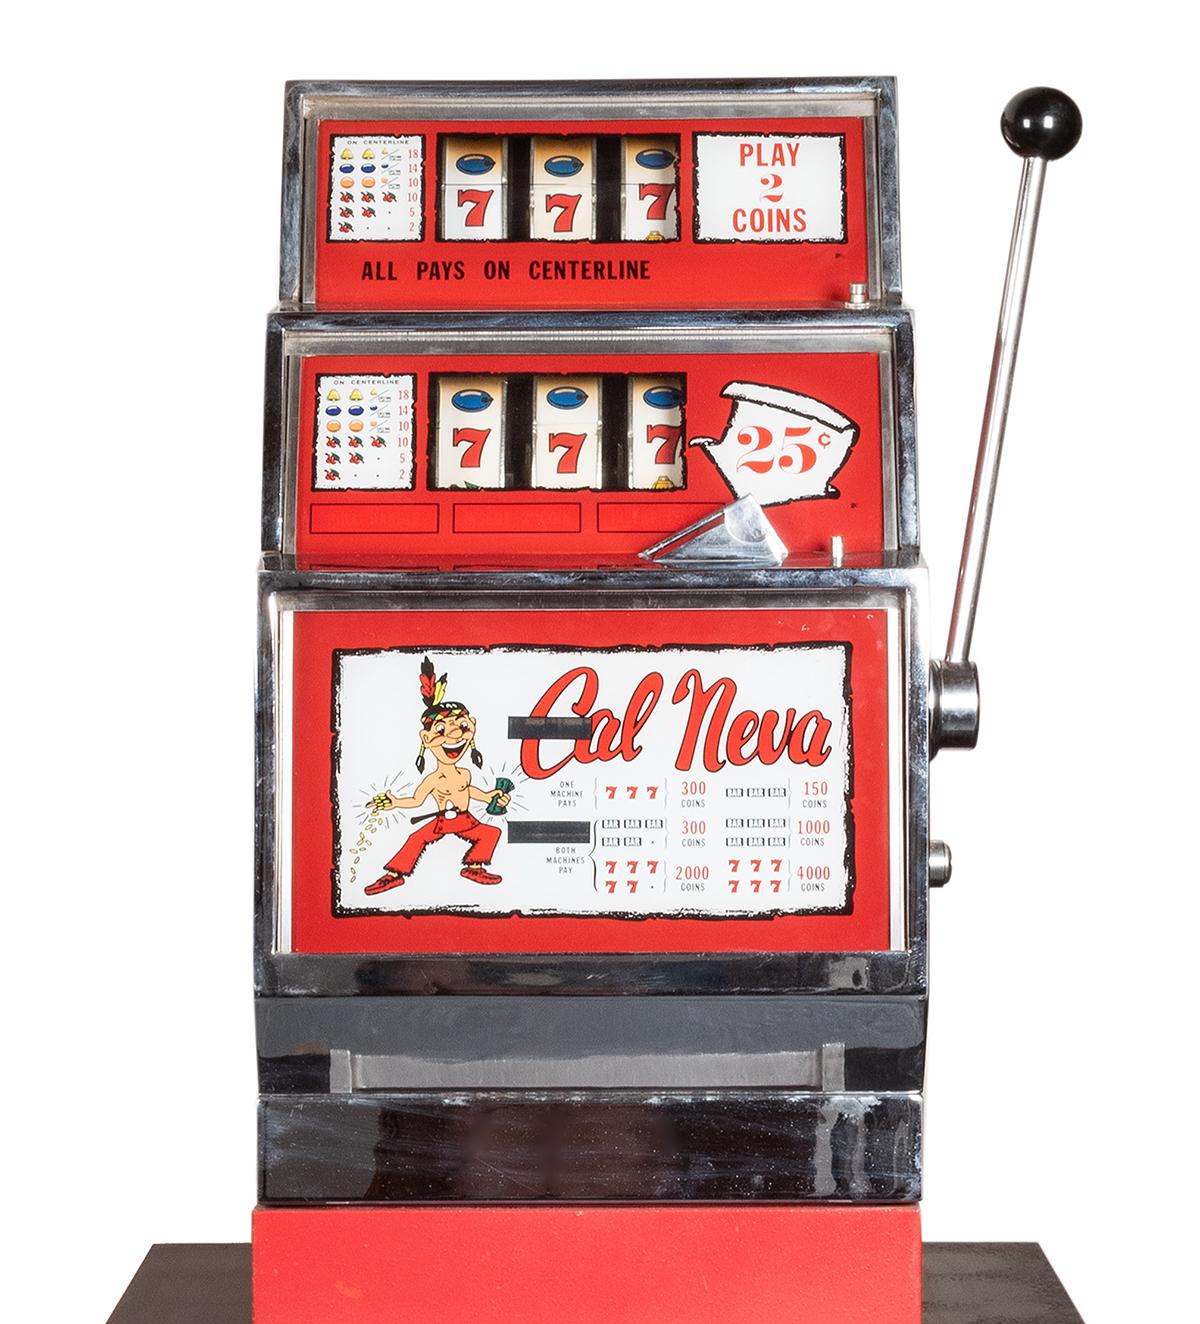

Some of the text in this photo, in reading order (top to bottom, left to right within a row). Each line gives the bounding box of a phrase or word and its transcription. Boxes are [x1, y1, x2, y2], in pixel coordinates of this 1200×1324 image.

[408, 149, 419, 158] 18
[740, 143, 800, 167] PLAY
[409, 164, 418, 173] 14
[409, 178, 419, 188] 10
[760, 173, 784, 203] 2
[408, 192, 418, 202] 10
[409, 208, 415, 217] 5
[457, 183, 675, 233] 7 7 7
[732, 208, 807, 233] COINS
[409, 222, 415, 232] 2
[361, 260, 651, 281] ALL PAYS ON CENTERLINE
[398, 390, 409, 400] 18
[399, 406, 408, 415] 14
[399, 422, 409, 431] 10
[398, 438, 409, 447] 10
[452, 424, 682, 474] 7 7 7
[736, 425, 832, 475] 25¢
[399, 453, 405, 463] 5
[399, 469, 405, 479] 2
[520, 666, 832, 780] Cal Neva
[550, 790, 583, 798] MACHINE
[605, 786, 659, 799] 7 7 7
[681, 781, 706, 796] 300
[804, 781, 828, 796] 150
[681, 799, 706, 808] COINS
[802, 799, 827, 808] COINS
[681, 820, 706, 835] 300
[798, 820, 831, 835] 1000
[681, 838, 706, 847] COINS
[800, 838, 825, 846] COINS
[605, 861, 659, 874] 7 7 7
[728, 859, 782, 873] 7 7 7
[675, 866, 709, 880] 2000
[797, 866, 831, 880] 4000
[605, 880, 638, 894] 7 7
[680, 883, 705, 892] COINS
[728, 880, 782, 893] 7 7 7
[801, 883, 825, 892] COINS
